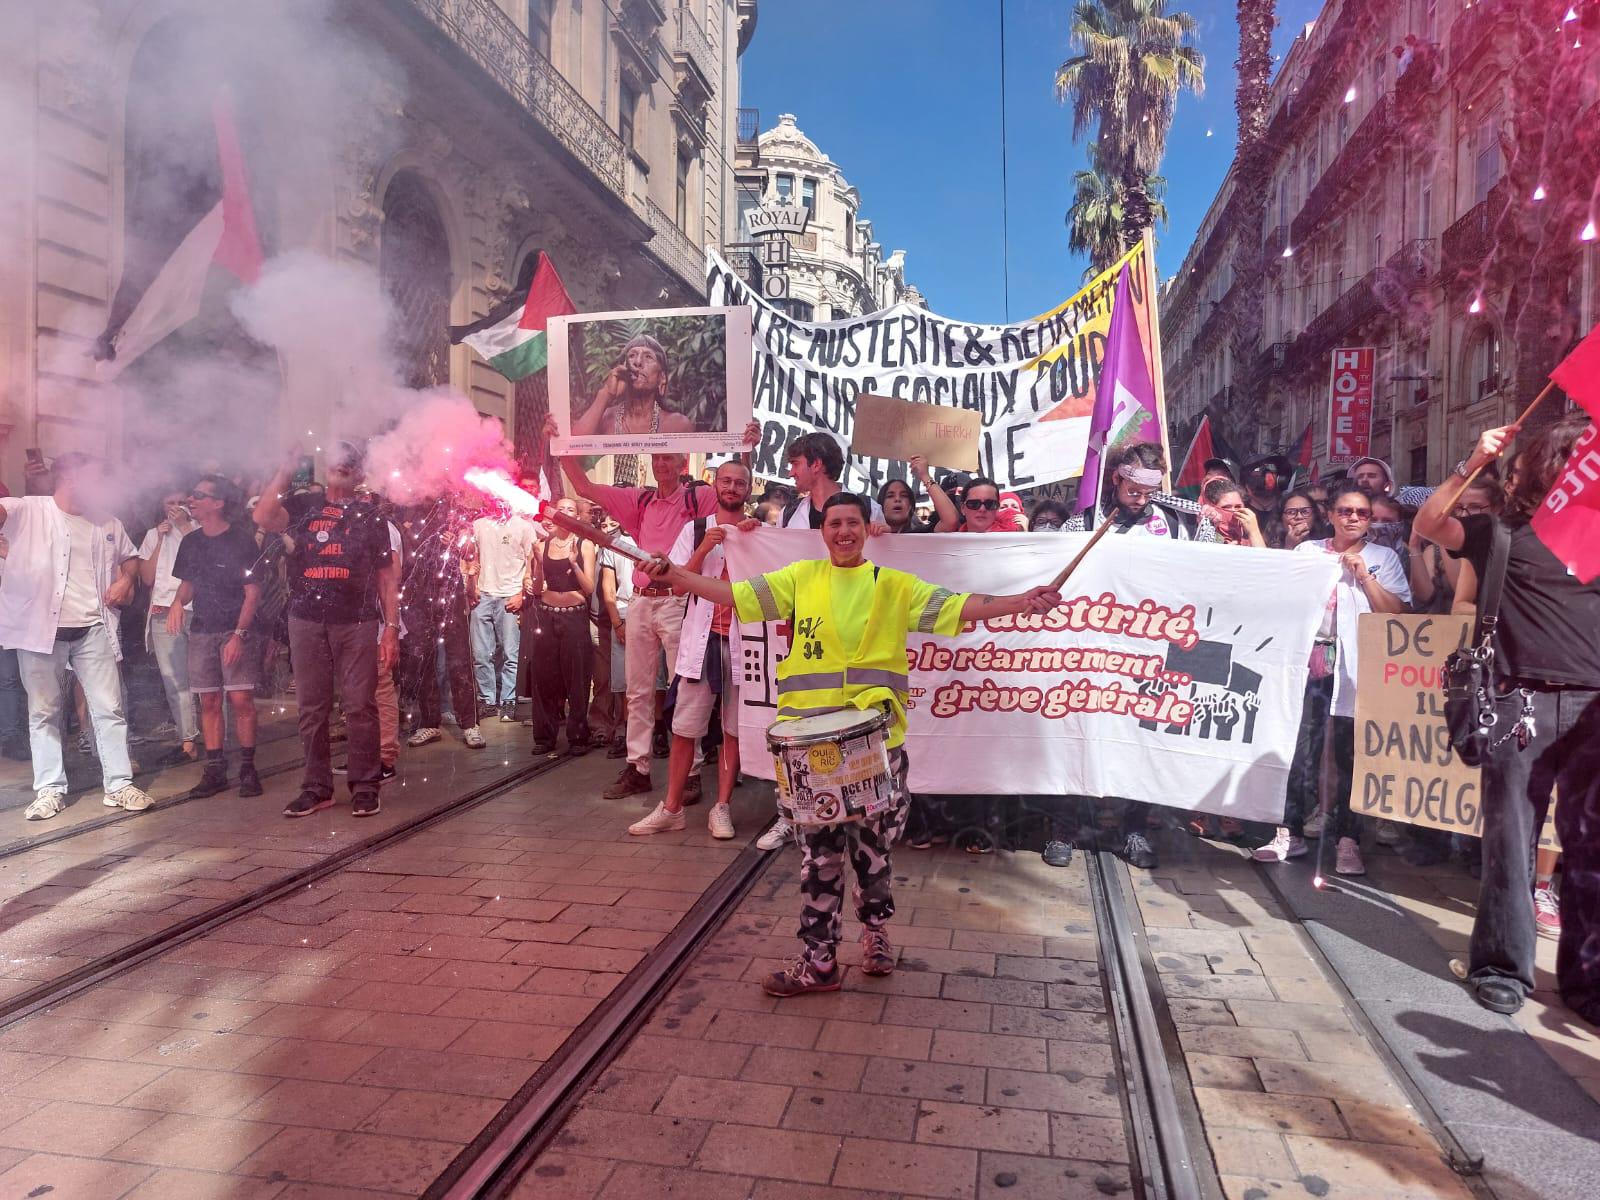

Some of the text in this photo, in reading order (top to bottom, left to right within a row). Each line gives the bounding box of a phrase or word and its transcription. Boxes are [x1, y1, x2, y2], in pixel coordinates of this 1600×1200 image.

[749, 211, 803, 227] ROYAL
[1336, 352, 1358, 455] HÔTEL
[803, 641, 824, 660] 34
[918, 642, 953, 671] le
[1386, 619, 1433, 657] DE
[1383, 662, 1442, 688] POU
[931, 678, 1043, 718] grève
[1364, 719, 1453, 767] DANS
[1362, 773, 1395, 814] DE
